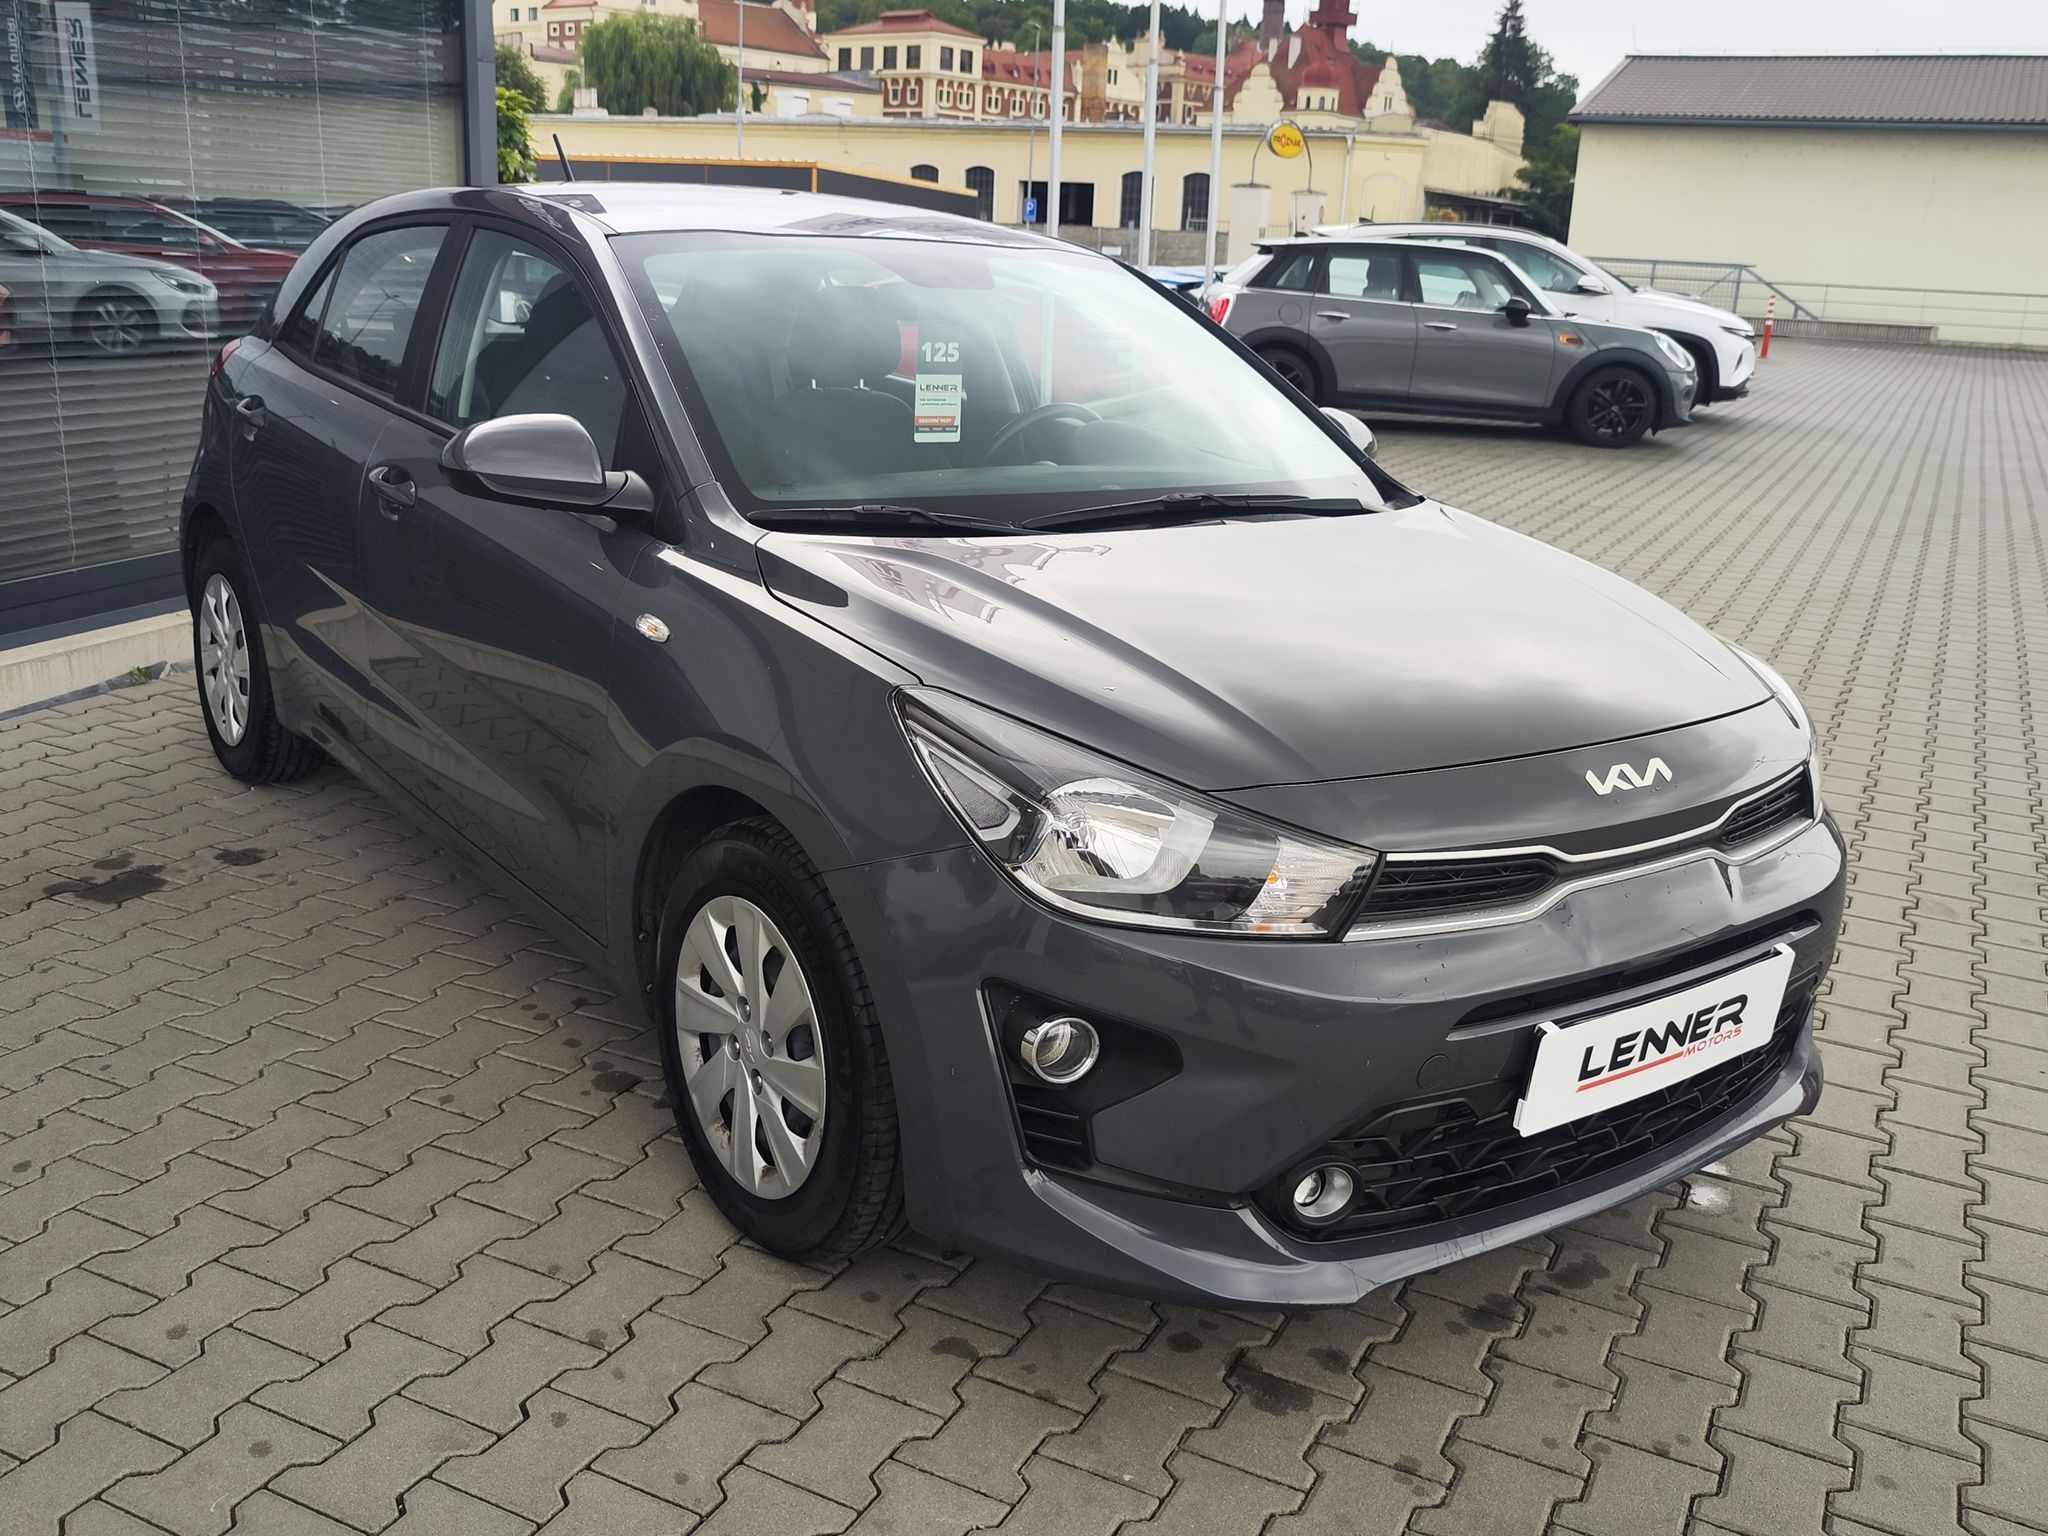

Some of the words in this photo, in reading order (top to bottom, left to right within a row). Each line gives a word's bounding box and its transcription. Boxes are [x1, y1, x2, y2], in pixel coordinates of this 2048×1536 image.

[1026, 201, 1034, 216] P
[921, 342, 960, 363] 125
[919, 384, 958, 392] LENNER
[1578, 993, 1749, 1082] LENNER
[1683, 1026, 1743, 1058] MOTORS
